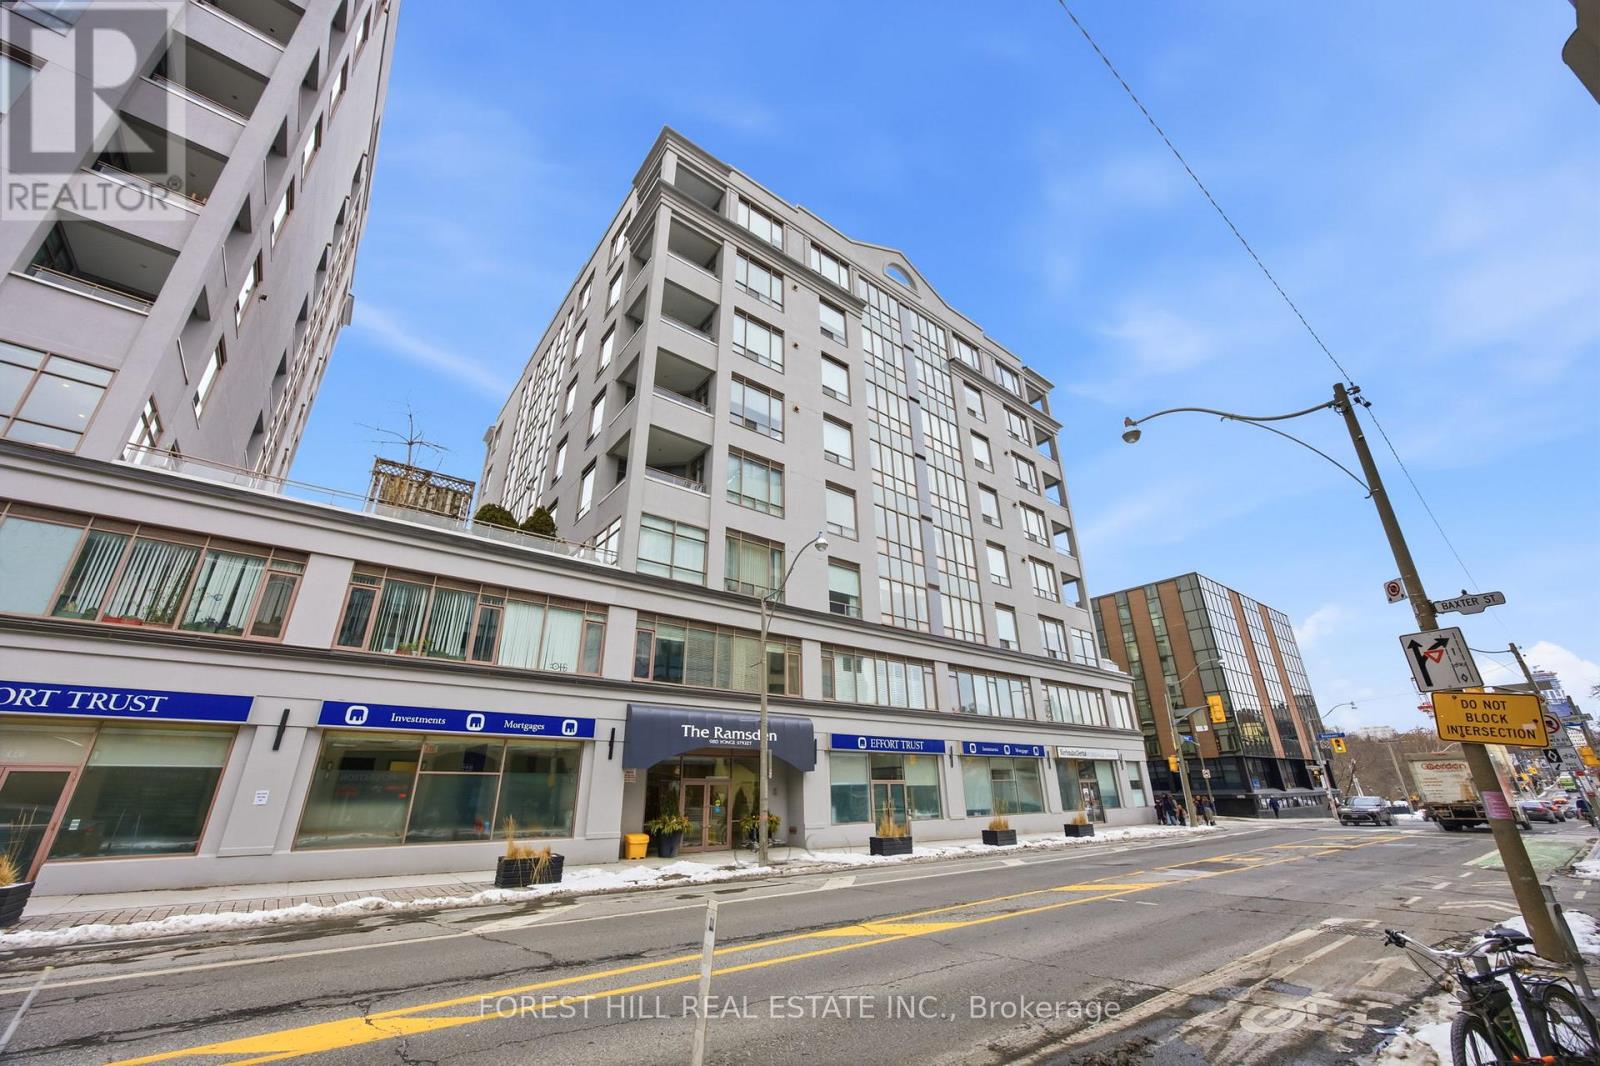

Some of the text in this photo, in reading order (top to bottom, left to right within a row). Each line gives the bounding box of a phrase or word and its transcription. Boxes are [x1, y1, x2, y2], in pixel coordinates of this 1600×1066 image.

[1441, 594, 1497, 610] BAXTER ST
[67, 690, 168, 713] TRUST
[1461, 699, 1507, 711] DO NOT
[390, 712, 545, 732] Investments Mortgages
[1465, 712, 1508, 724] BLOCK
[681, 724, 777, 742] The Ramsdn
[1446, 725, 1537, 740] INTERSECTION
[870, 738, 925, 750] EFFORT TRUST
